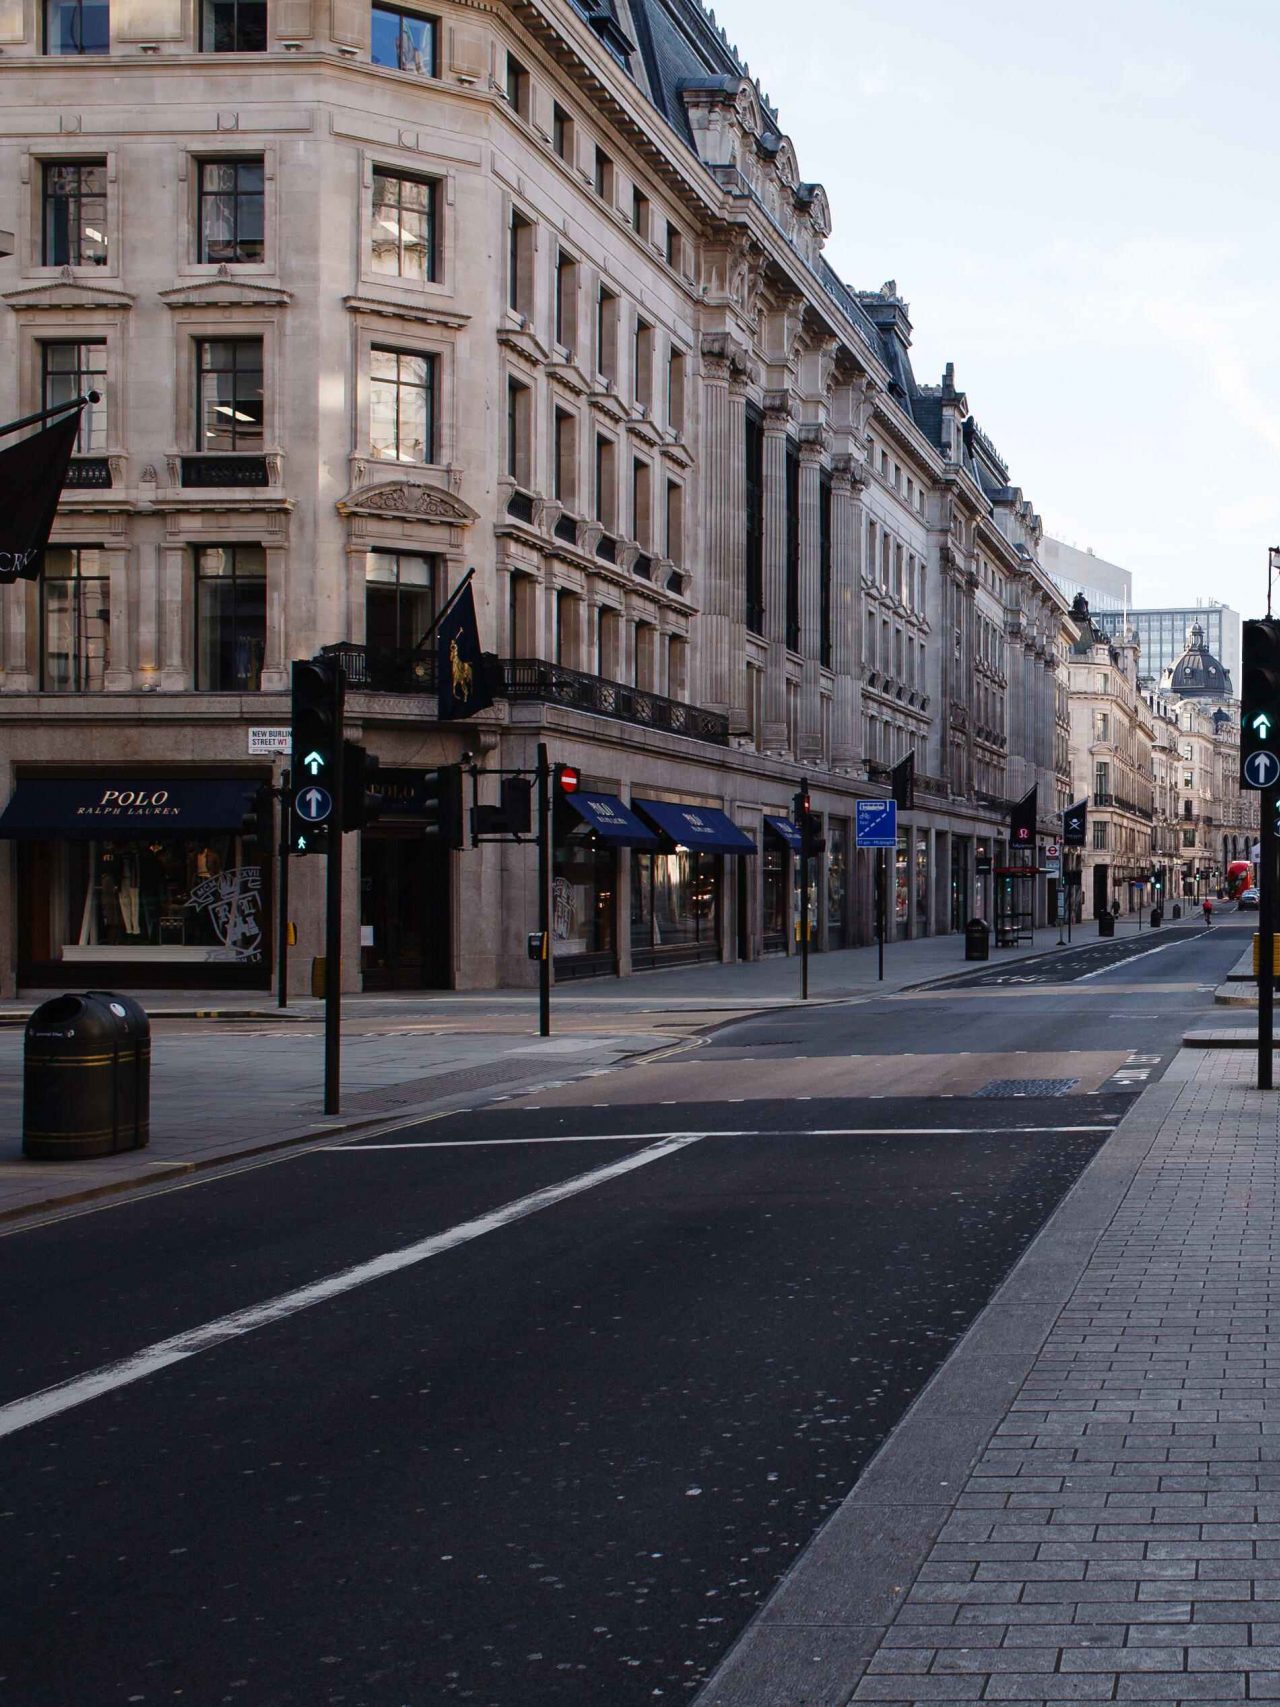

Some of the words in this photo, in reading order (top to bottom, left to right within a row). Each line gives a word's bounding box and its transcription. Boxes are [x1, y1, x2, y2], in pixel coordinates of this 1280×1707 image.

[252, 730, 267, 738] NEW
[252, 738, 276, 746] STREET
[277, 738, 287, 746] W1
[100, 790, 169, 806] POLO
[77, 807, 121, 815] RALPH
[127, 807, 181, 815] LAUREN
